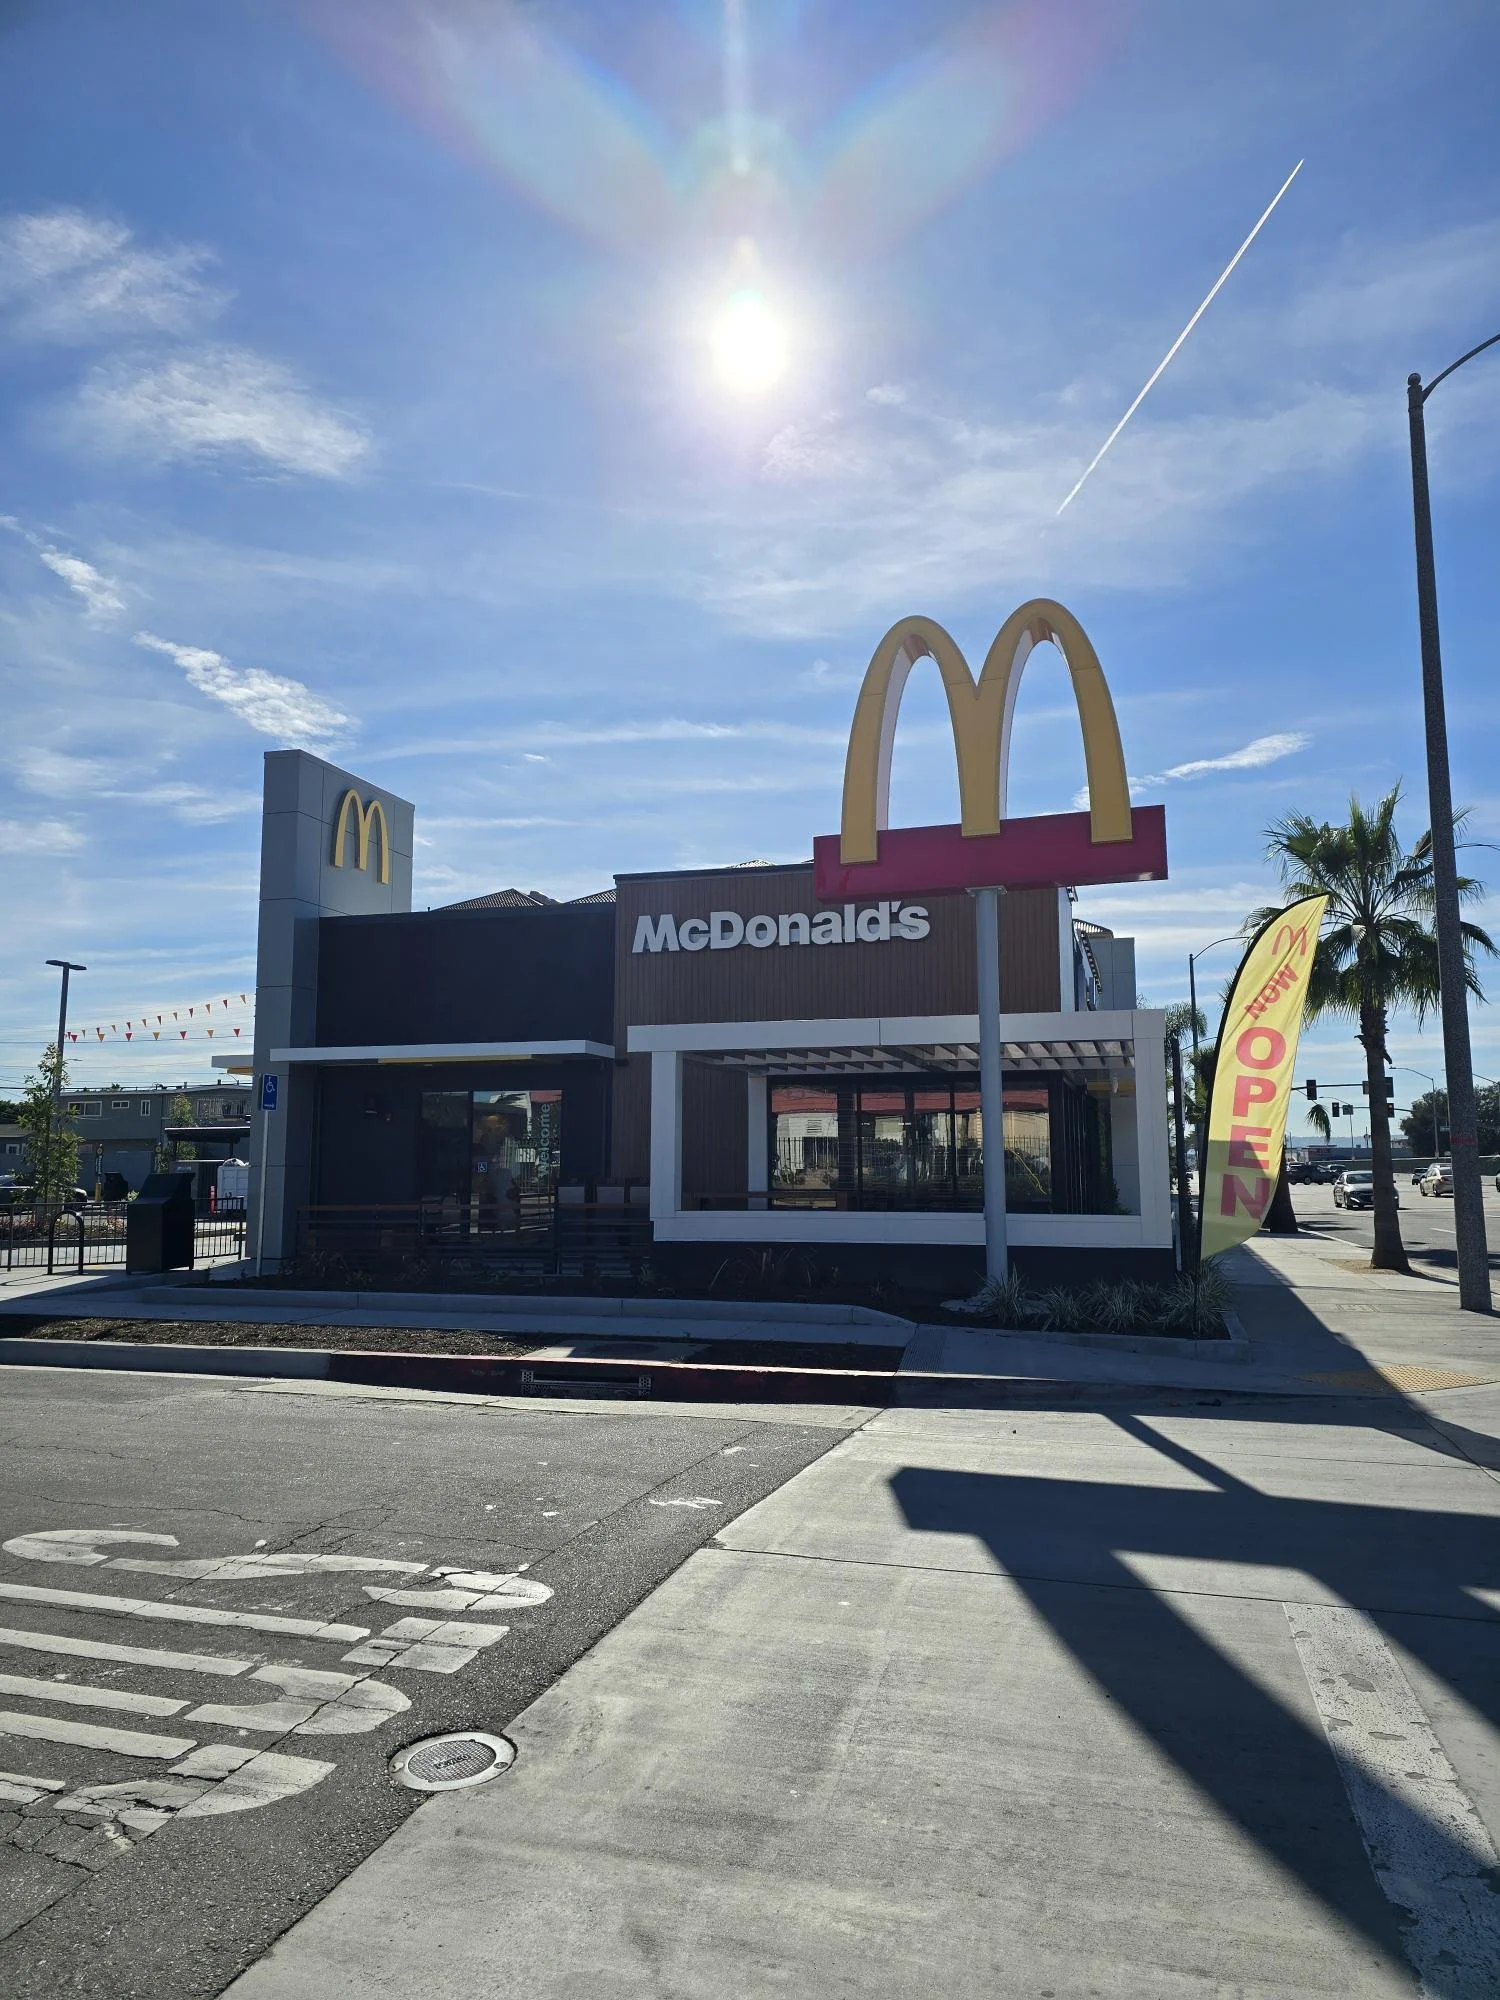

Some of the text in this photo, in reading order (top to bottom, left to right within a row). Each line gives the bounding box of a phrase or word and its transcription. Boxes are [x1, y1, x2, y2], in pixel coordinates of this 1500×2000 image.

[631, 900, 930, 953] McDonald's
[1245, 964, 1299, 1020] NOW
[537, 1103, 551, 1177] welcome
[1220, 1026, 1287, 1219] OPEN
